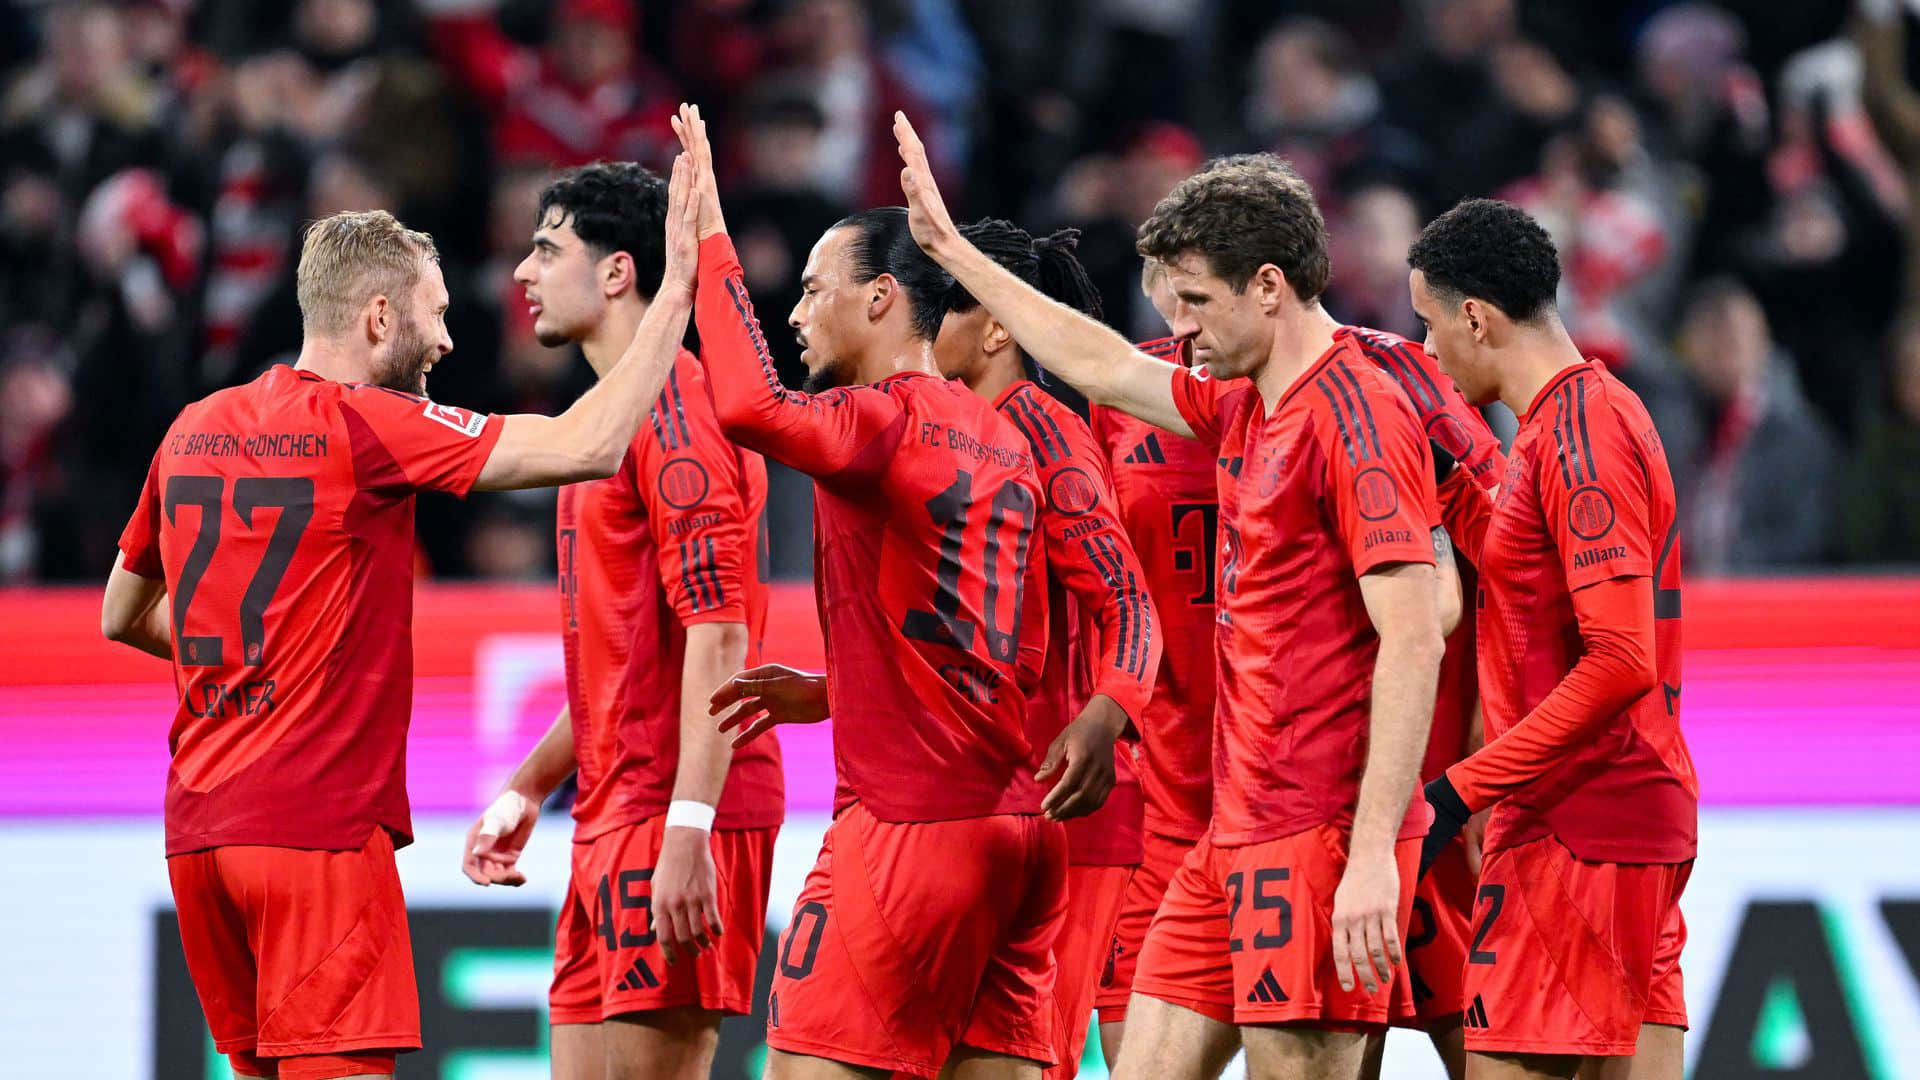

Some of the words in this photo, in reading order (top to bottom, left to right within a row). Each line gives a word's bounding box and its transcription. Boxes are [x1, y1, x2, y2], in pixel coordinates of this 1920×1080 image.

[184, 433, 239, 457] BAYERN
[243, 432, 328, 457] MÜNCHEN
[921, 422, 940, 447] FC
[668, 512, 721, 536] Allianz
[1364, 528, 1411, 552] Allianz
[901, 469, 1036, 665] 10
[1574, 546, 1627, 570] Allianz
[163, 475, 315, 667] 27
[596, 868, 658, 951] 45
[1225, 867, 1293, 953] 25
